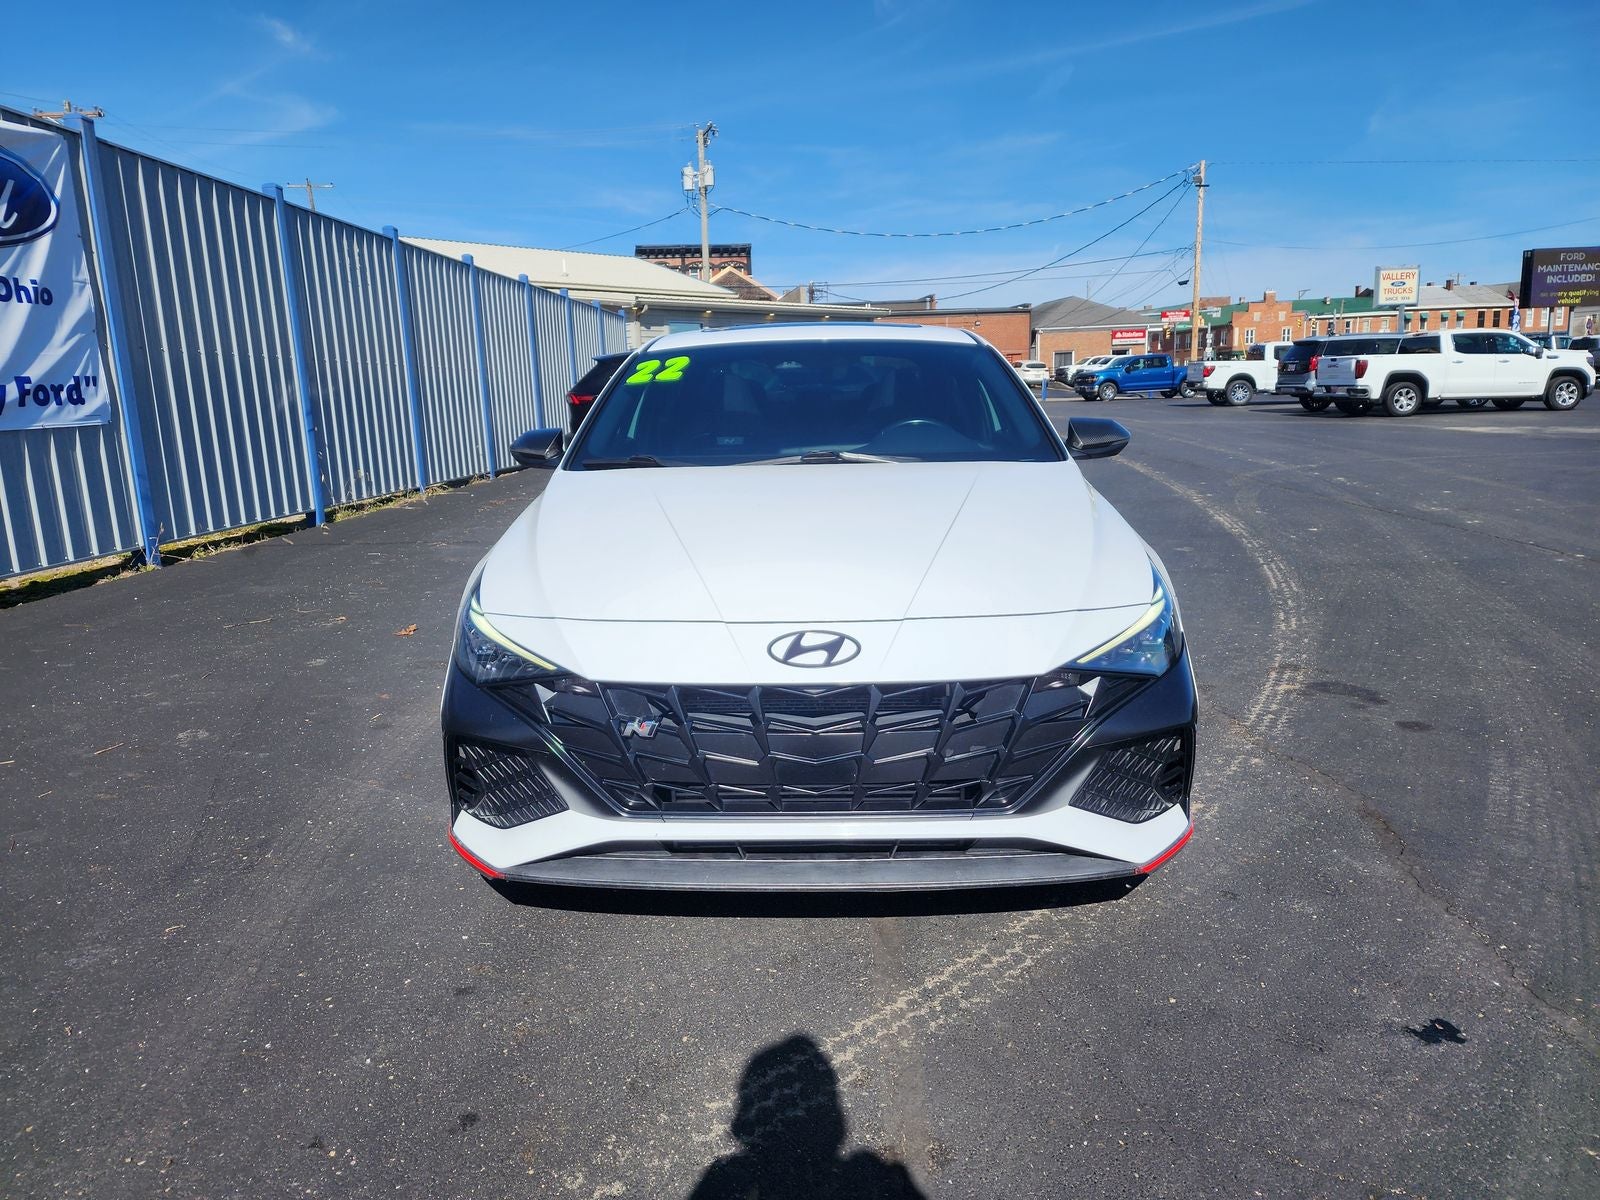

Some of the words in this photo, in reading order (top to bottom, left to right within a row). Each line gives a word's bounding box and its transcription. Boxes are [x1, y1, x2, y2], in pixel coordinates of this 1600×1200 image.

[1560, 252, 1586, 261] FORD
[1381, 271, 1416, 281] VALLERY
[1546, 273, 1596, 284] INCLUDED!
[0, 276, 53, 306] Ohio
[1383, 287, 1413, 295] TRUCKS
[625, 356, 690, 385] 22
